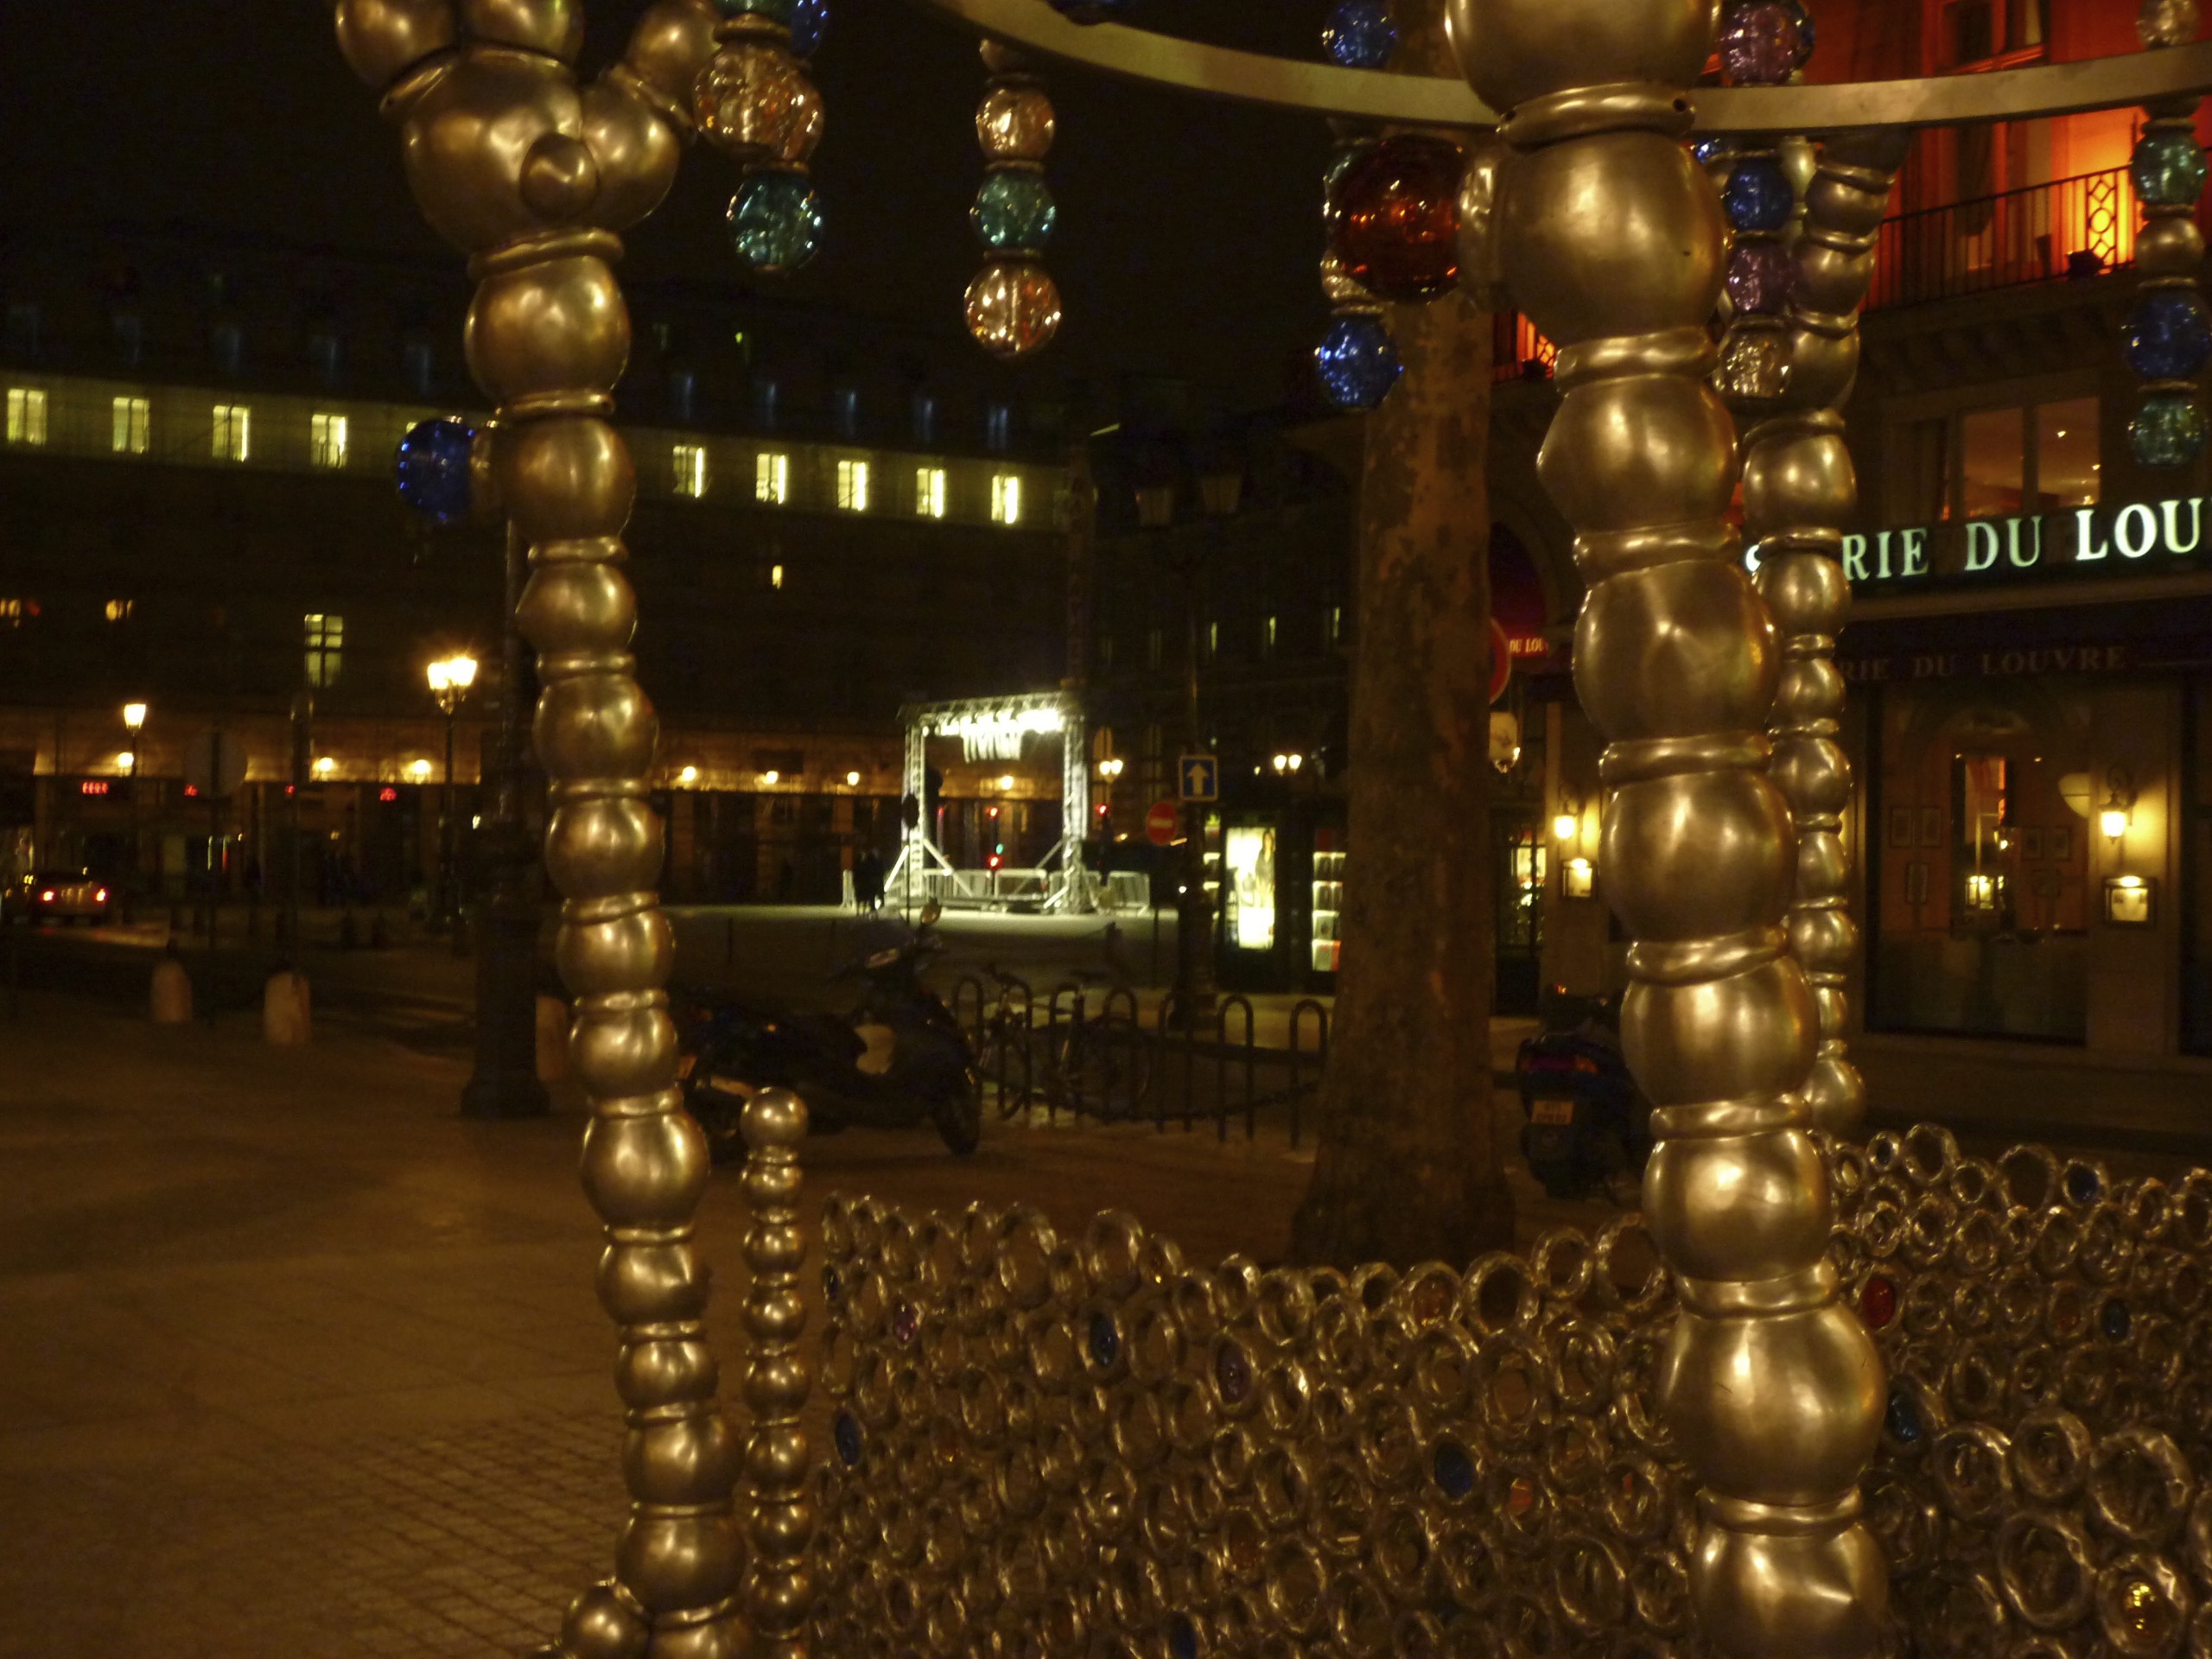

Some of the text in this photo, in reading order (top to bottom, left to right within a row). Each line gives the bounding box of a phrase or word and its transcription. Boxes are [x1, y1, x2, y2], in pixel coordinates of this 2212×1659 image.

[1964, 516, 2043, 571] DU
[2075, 497, 2212, 561] LOU
[1913, 654, 1955, 677] DU
[1982, 645, 2126, 676] LOUVRE
